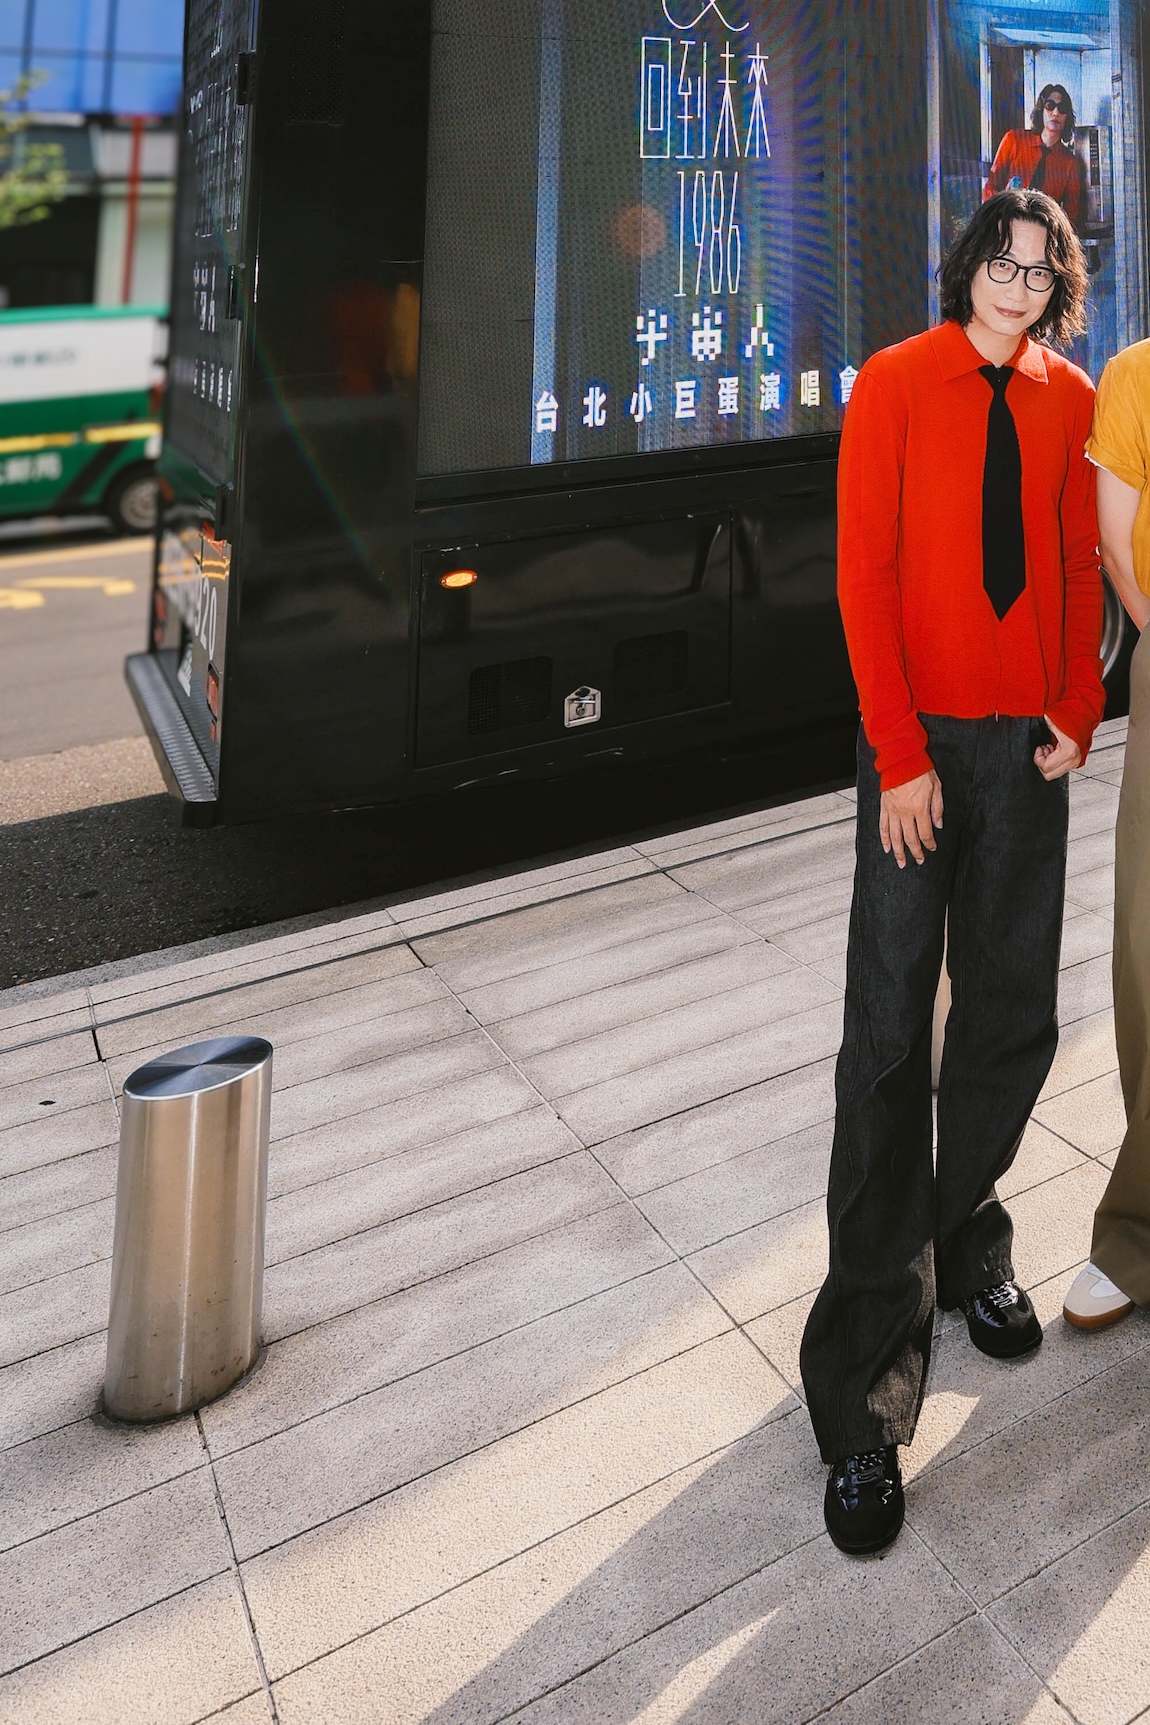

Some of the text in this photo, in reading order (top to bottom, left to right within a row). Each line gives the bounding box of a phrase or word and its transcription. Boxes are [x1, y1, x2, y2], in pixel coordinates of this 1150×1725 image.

[640, 36, 771, 159] 回到未來
[674, 171, 741, 298] 1986
[636, 303, 775, 367] 宇宙人
